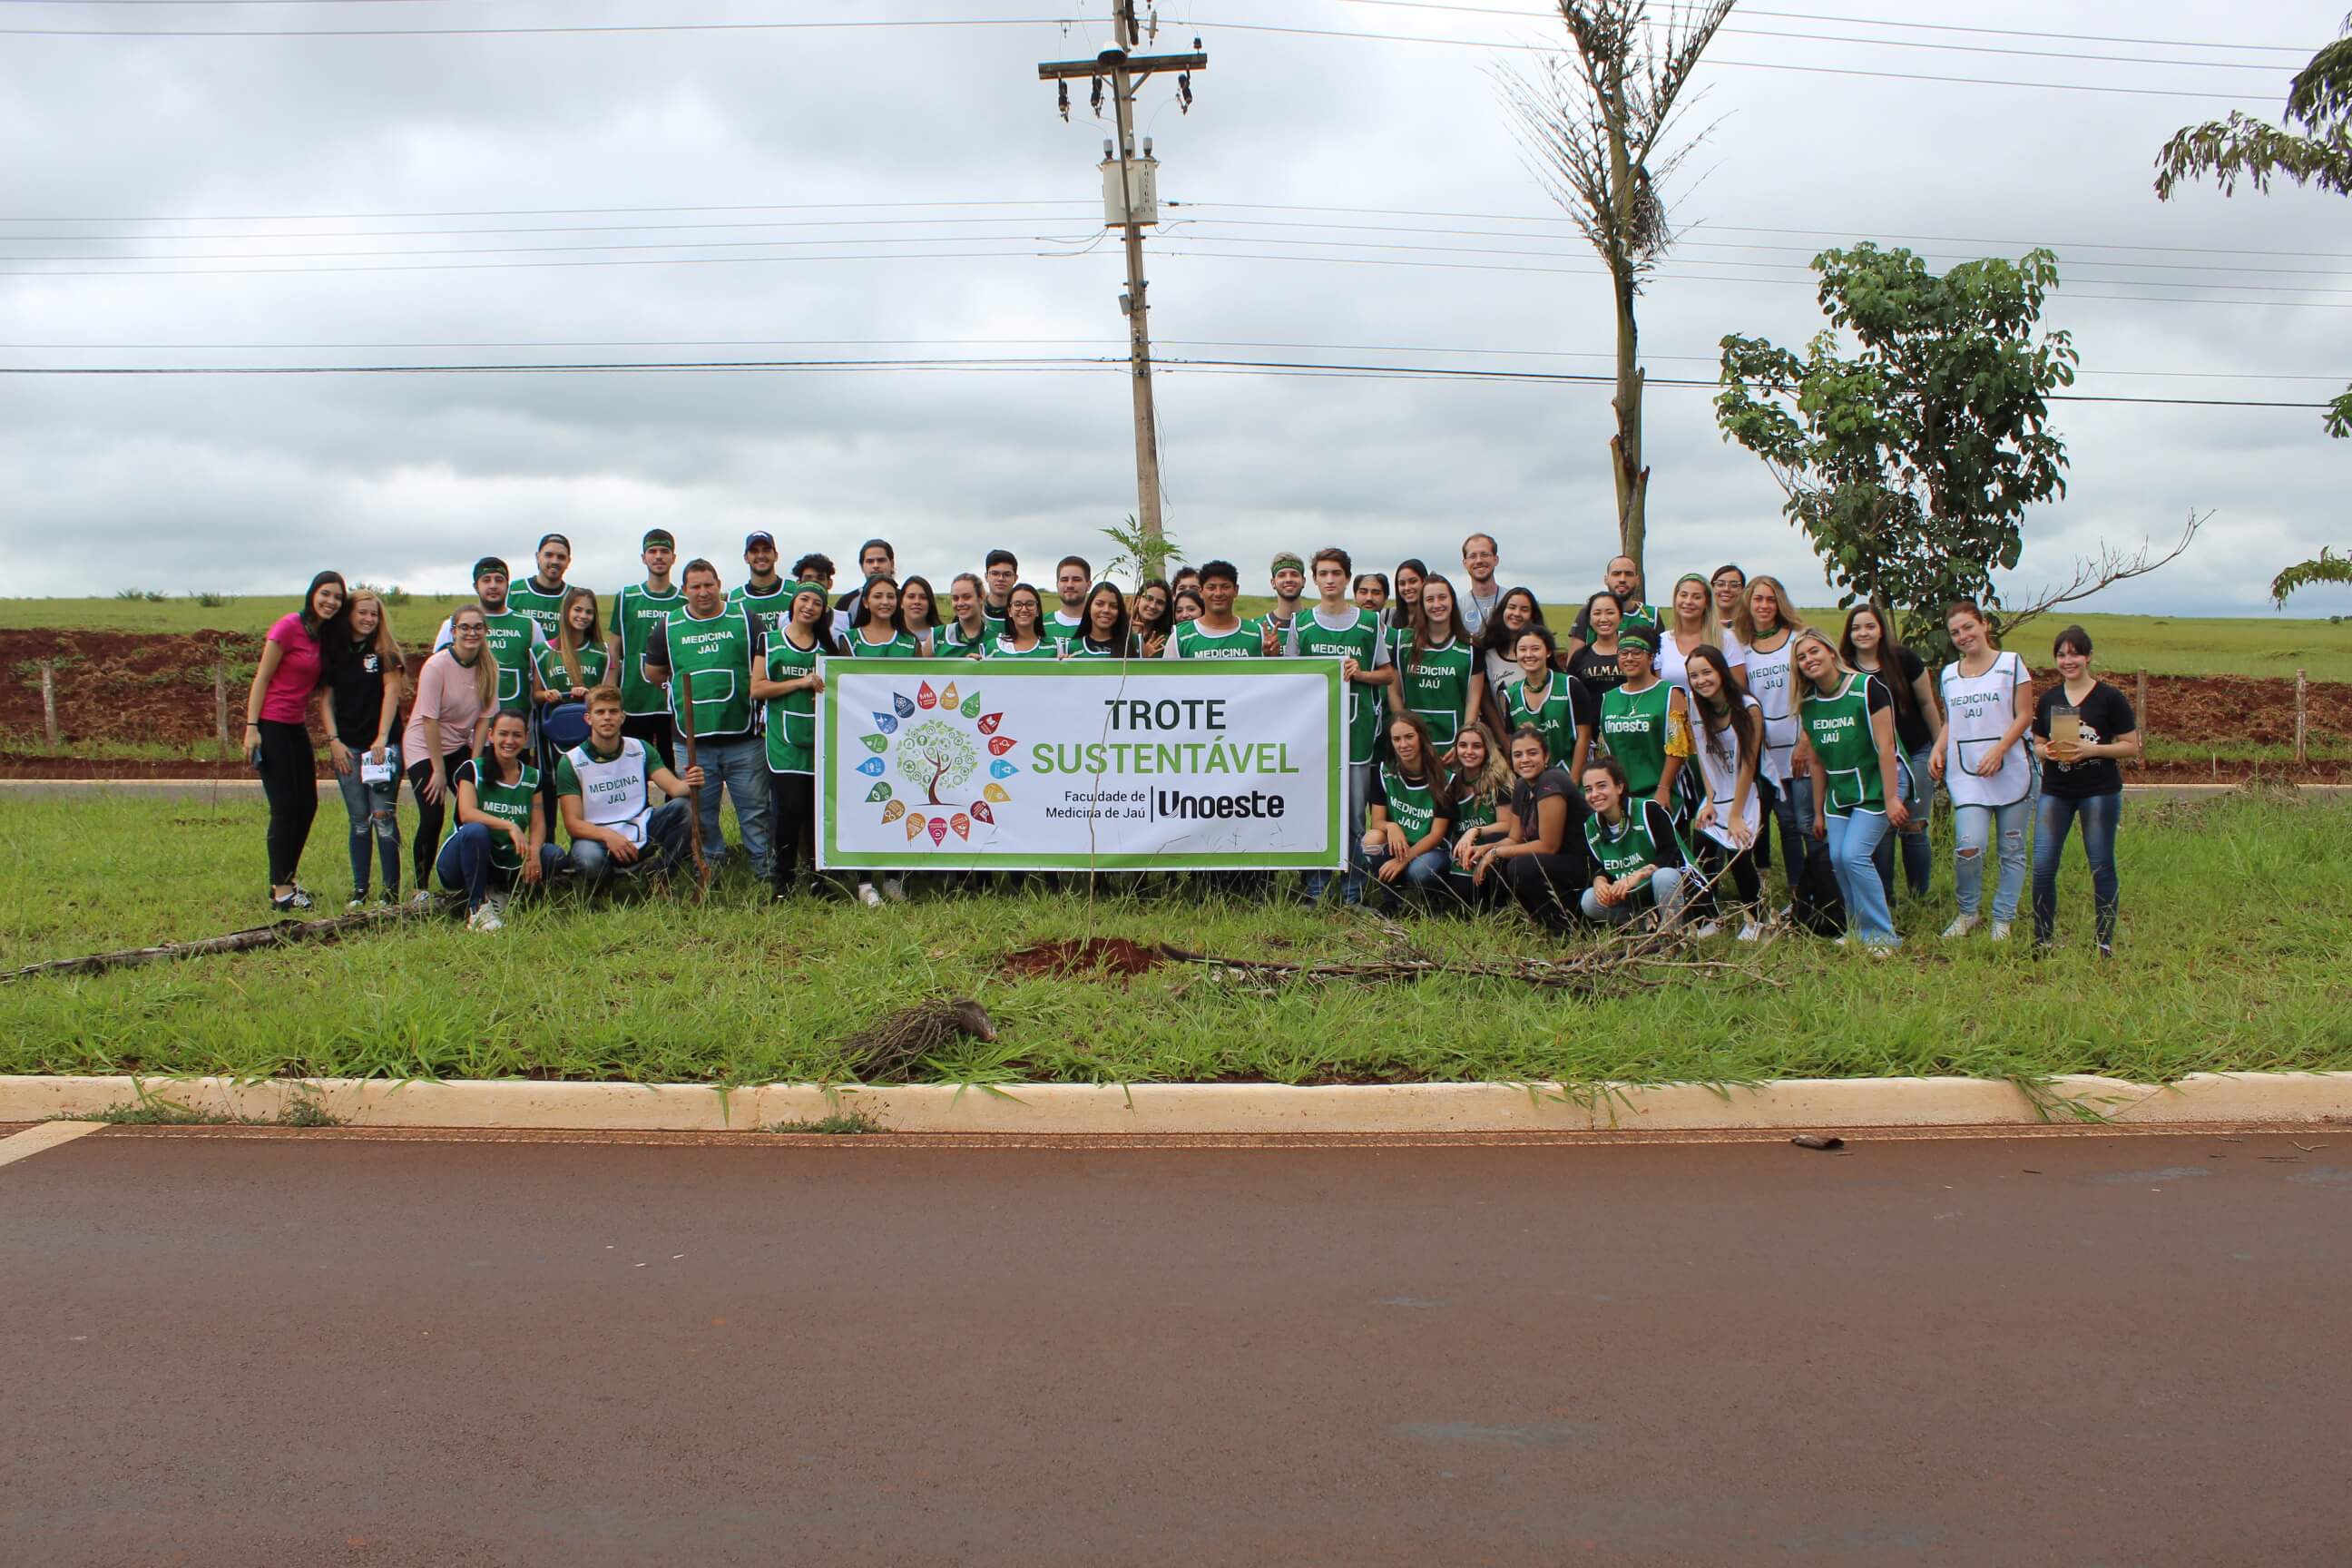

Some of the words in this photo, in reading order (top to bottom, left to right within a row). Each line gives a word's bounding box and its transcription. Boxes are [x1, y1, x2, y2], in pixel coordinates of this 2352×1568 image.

[681, 631, 734, 645] MEDICINA
[697, 642, 720, 654] JAÚ
[1194, 648, 1250, 660] MEDICINA
[1310, 643, 1362, 657] MEDICINA
[1749, 662, 1790, 681] MEDICIN
[1418, 677, 1441, 689] JAÚ
[1104, 700, 1227, 730] TROTE
[1813, 716, 1856, 730] EDICINA
[1820, 729, 1840, 744] JAÚ
[1032, 735, 1299, 774] SUSTENTÁVEL
[1131, 790, 1146, 802] de
[1159, 790, 1285, 819] Unoeste
[1390, 796, 1434, 819] MEDICINA
[1045, 807, 1102, 818] Medicina
[1104, 807, 1120, 818] de
[1122, 807, 1145, 818] Jaú
[1398, 815, 1420, 830] JAÚ
[1603, 852, 1644, 870] EDICINA
